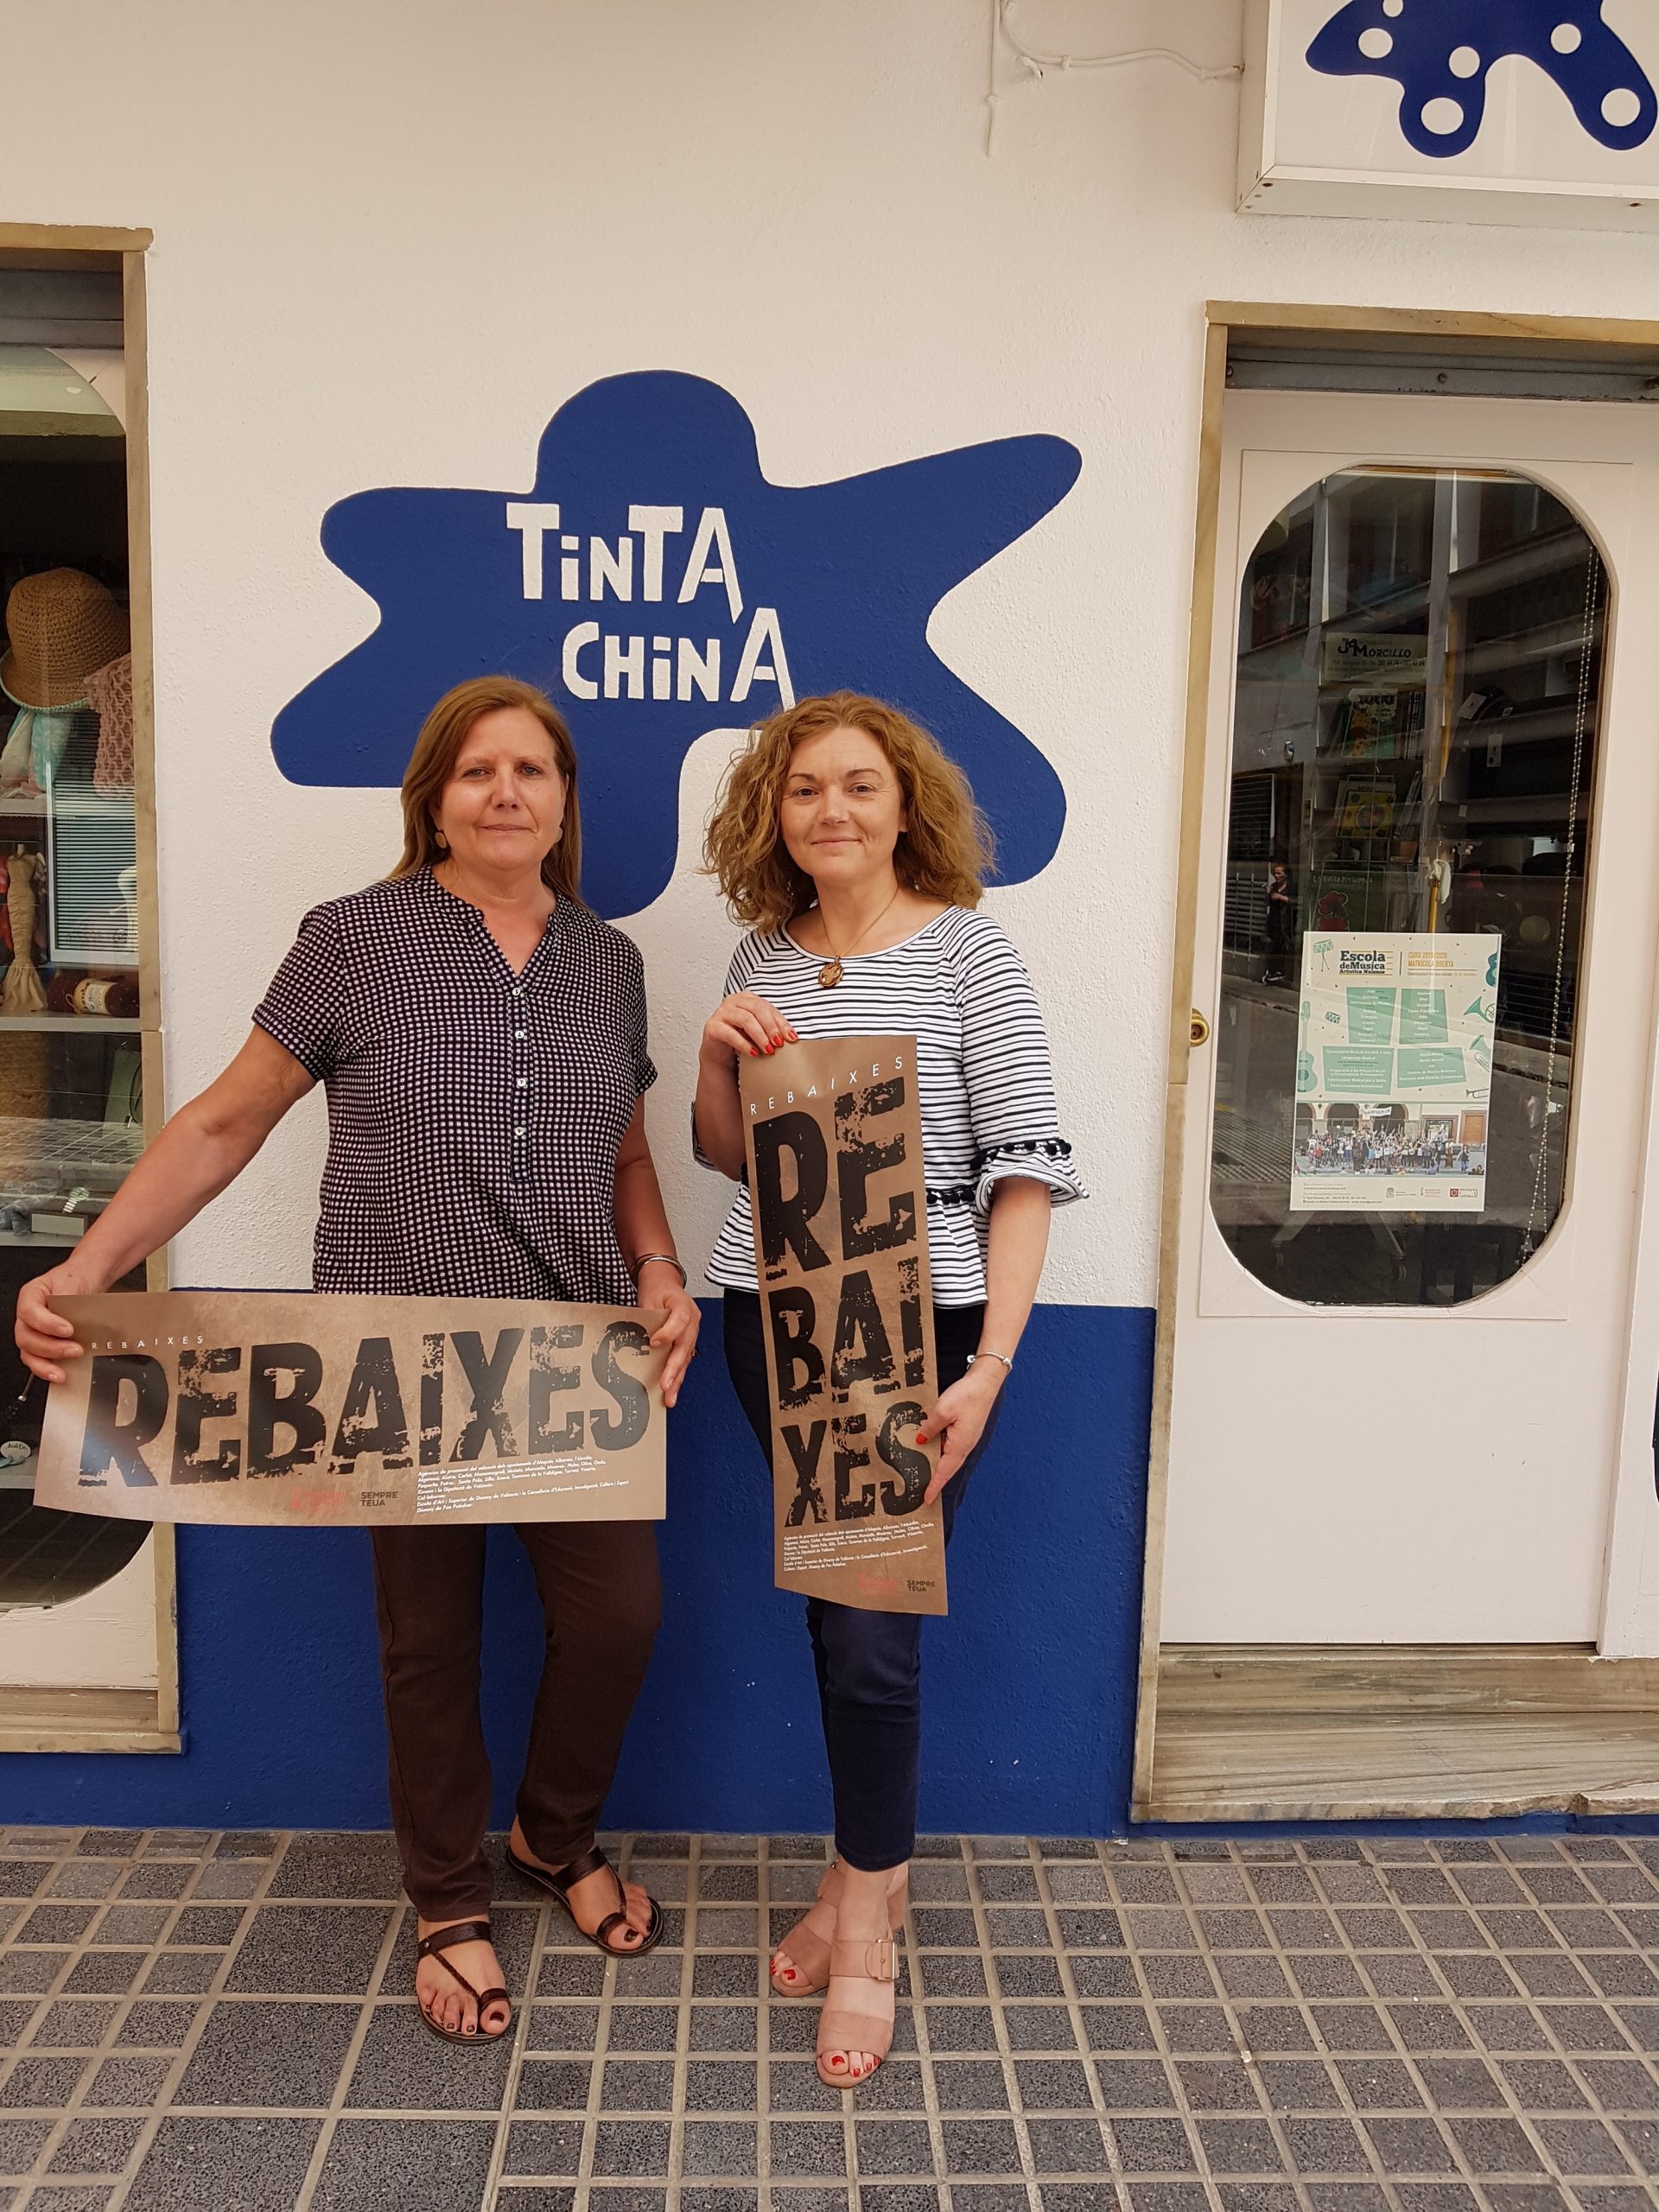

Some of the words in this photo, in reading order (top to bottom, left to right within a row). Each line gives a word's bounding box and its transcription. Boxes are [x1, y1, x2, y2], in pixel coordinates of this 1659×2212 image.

[1340, 950, 1385, 962] Escola
[749, 1055, 904, 1116] REBAIXES
[753, 1077, 917, 1281] RE
[90, 1333, 207, 1351] REBAIXES
[767, 1256, 925, 1412] BAI
[79, 1319, 652, 1487] REBAIXES
[359, 1491, 398, 1499] SEMPRE
[779, 1401, 932, 1528] XES
[906, 1579, 936, 1588] SEMPRE
